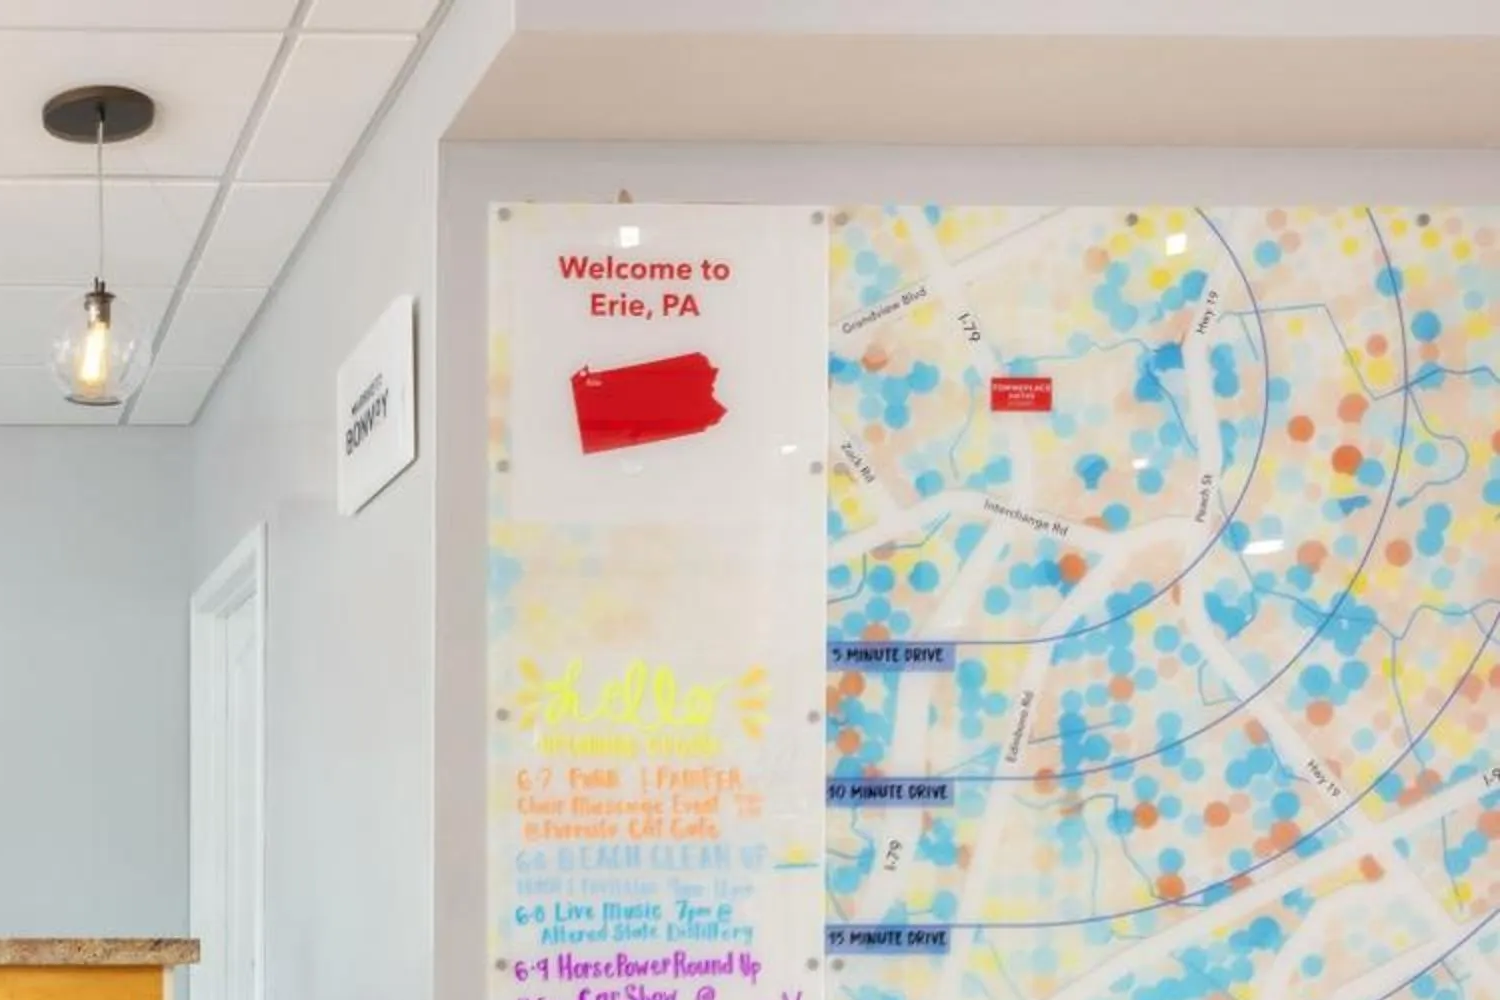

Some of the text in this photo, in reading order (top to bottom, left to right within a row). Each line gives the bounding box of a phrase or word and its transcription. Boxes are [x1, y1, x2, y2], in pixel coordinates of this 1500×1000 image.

[559, 256, 731, 281] Welcome to
[590, 293, 700, 321] Erie, PA
[842, 286, 928, 334] Grandview Blvd
[957, 312, 981, 342] I-79
[860, 464, 876, 484] Rd
[983, 498, 1069, 537] Interchange Rd
[832, 648, 945, 662] 5 MINUTE DRIVE
[1483, 766, 1500, 788] I-9
[828, 784, 949, 799] 10 MINUTE DRIVE
[883, 839, 903, 872] I-79
[554, 900, 596, 922] Live
[603, 899, 662, 921] Music
[829, 931, 946, 946] 15 MINUTE DRIVE
[739, 951, 762, 985] Up
